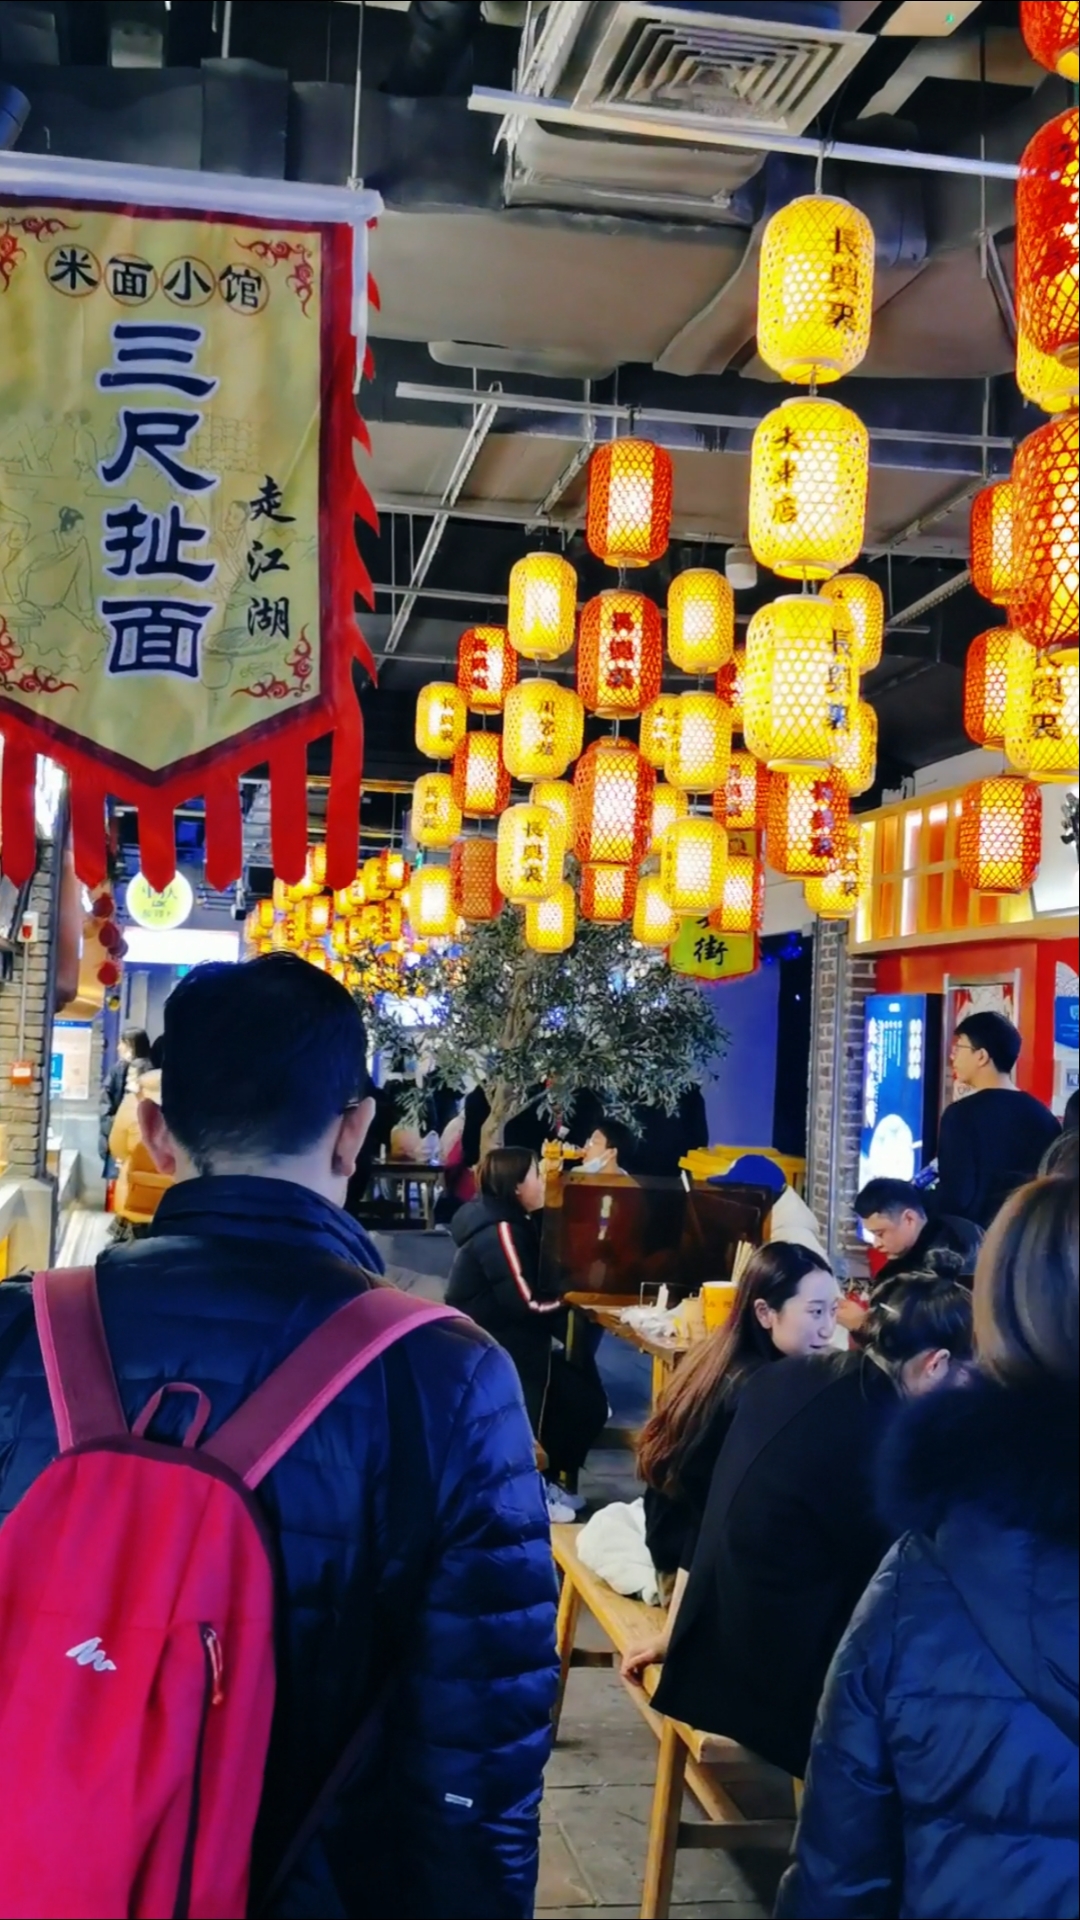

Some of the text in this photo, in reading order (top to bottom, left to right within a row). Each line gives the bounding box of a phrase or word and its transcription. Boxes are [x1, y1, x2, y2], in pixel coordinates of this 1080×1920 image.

[50, 249, 262, 309] 米面小馆
[100, 324, 217, 678] 三尺扯面
[247, 475, 297, 640] 走江湖
